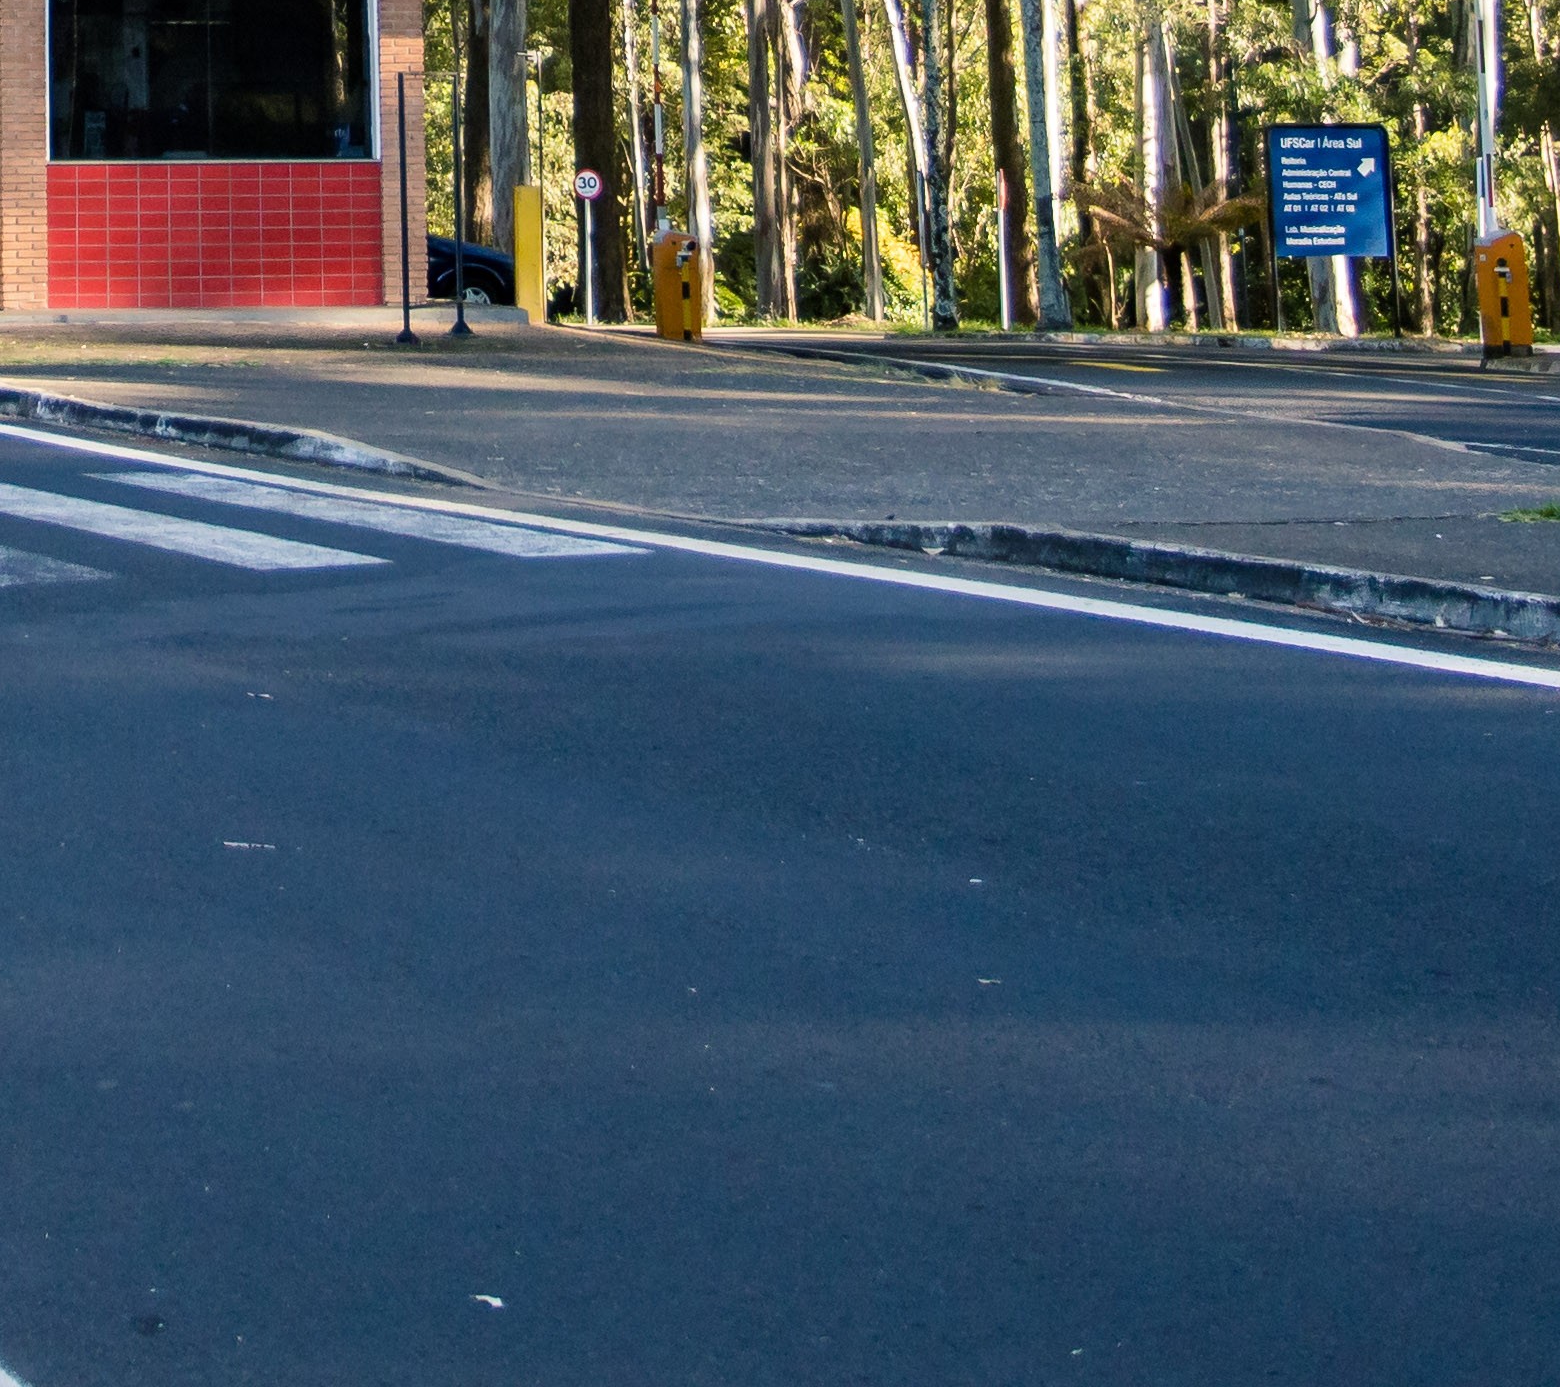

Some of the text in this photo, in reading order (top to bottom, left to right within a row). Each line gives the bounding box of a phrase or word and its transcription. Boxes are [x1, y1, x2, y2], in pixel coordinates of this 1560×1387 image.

[1280, 138, 1315, 149] UFSCar
[1322, 136, 1345, 149] Área
[1346, 137, 1362, 149] Sul
[578, 177, 597, 188] 30
